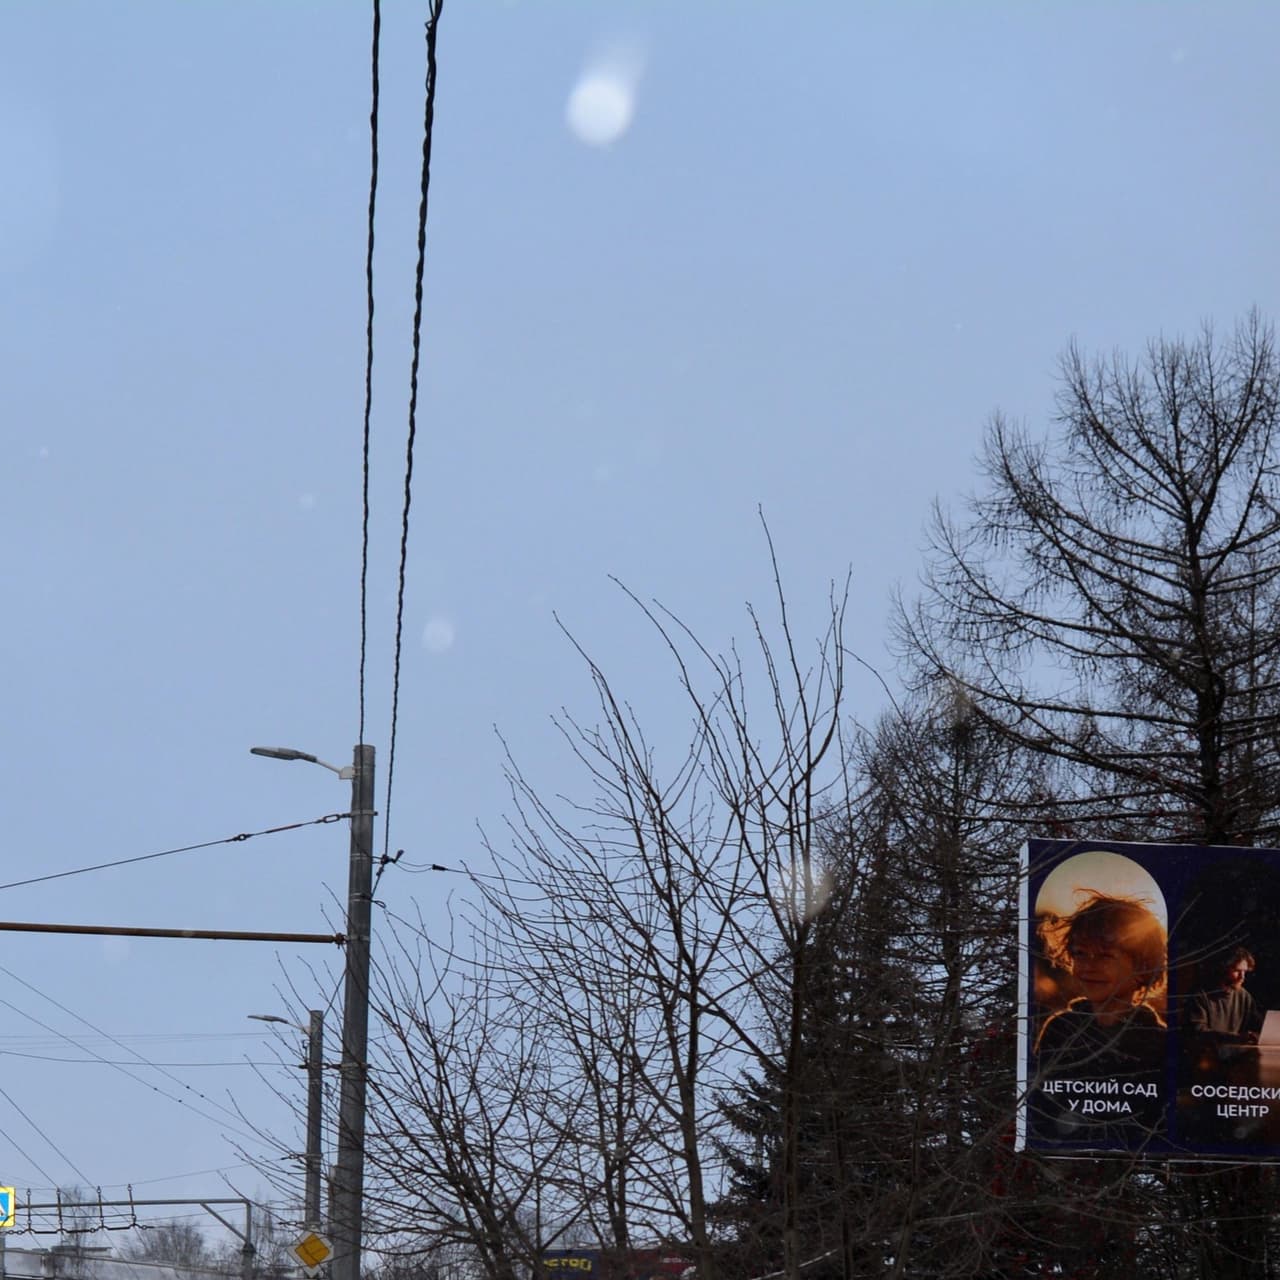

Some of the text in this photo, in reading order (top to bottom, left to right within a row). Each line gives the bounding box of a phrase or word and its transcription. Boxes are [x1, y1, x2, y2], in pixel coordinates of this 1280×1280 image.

[1042, 1078, 1158, 1098] ДЕТСКИЙ САД
[1068, 1099, 1133, 1114] У ДОМА
[1216, 1104, 1270, 1119] ЦЕНТР
